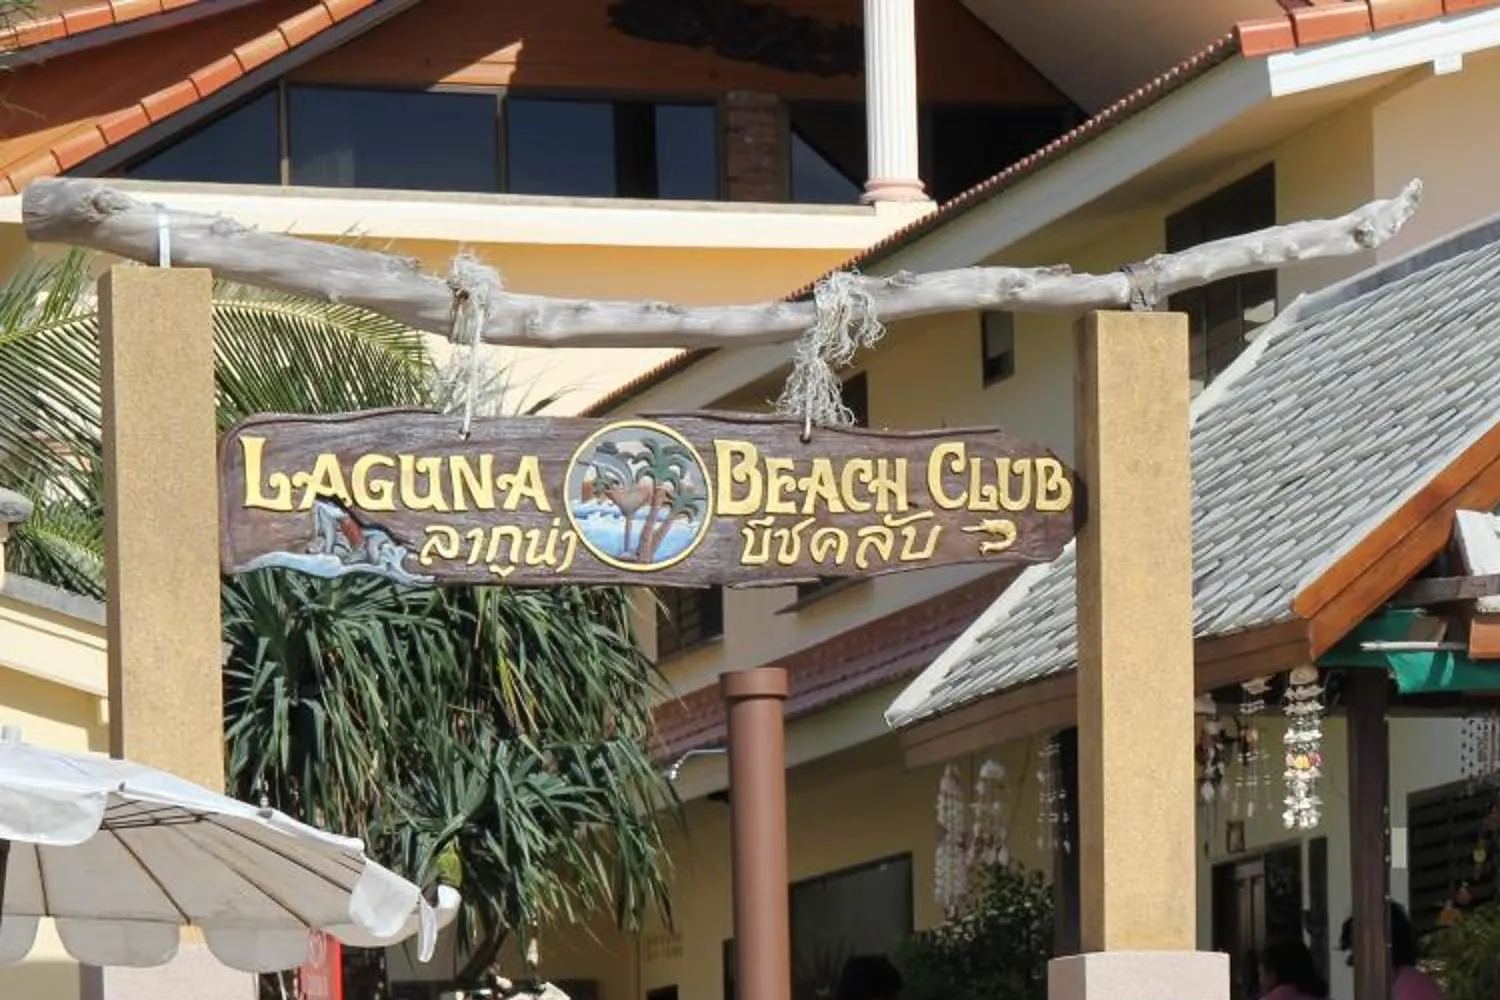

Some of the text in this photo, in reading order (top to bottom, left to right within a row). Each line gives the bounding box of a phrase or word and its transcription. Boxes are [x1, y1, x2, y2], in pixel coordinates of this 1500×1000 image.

[239, 434, 1074, 515] LAGUNA BEACH CLUB
